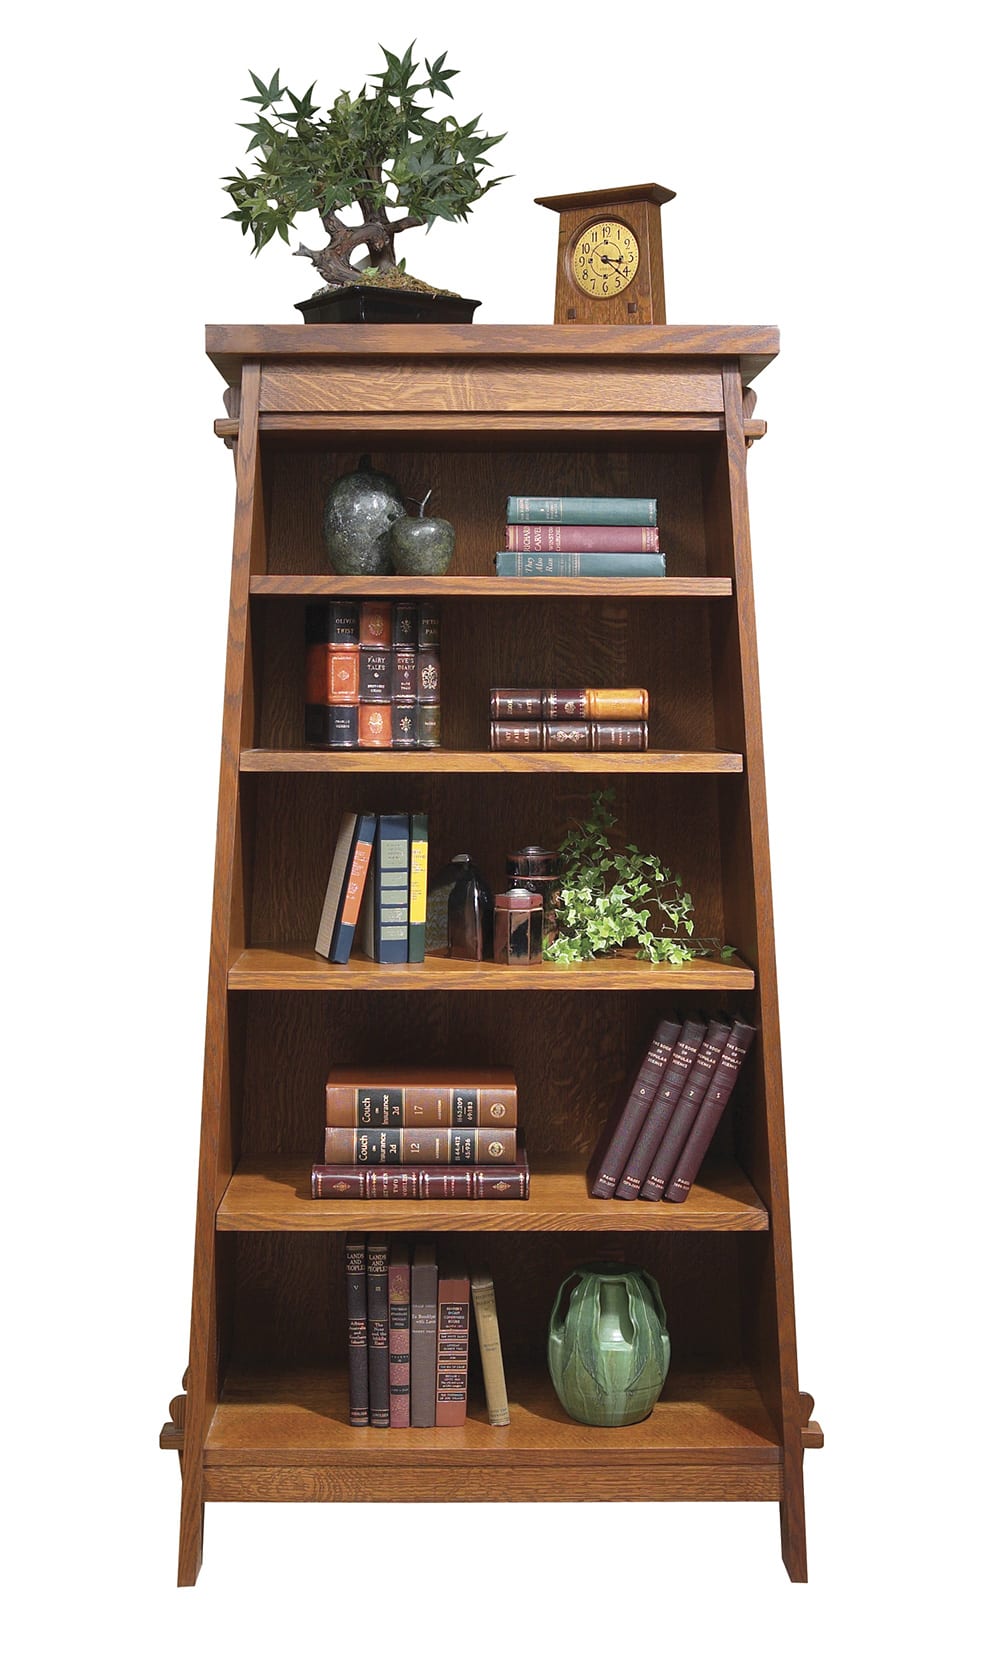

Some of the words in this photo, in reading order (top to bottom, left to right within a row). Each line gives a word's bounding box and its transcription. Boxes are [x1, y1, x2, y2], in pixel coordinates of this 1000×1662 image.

[592, 232, 597, 242] 11
[602, 226, 611, 238] 12
[617, 230, 620, 240] 1
[582, 243, 590, 254] 10
[624, 239, 630, 250] 2
[579, 256, 585, 267] 9
[628, 252, 634, 262] 3
[582, 269, 588, 280] 8
[623, 266, 630, 277] 4
[590, 279, 596, 290] 7
[602, 282, 608, 292] 6
[615, 277, 620, 288] 5
[525, 557, 535, 573] They
[362, 1097, 371, 1123] Couch
[392, 1106, 400, 1116] 2d
[414, 1105, 423, 1115] 17
[359, 1135, 368, 1161] Couch
[389, 1144, 397, 1154] 2d
[411, 1143, 420, 1153] 12
